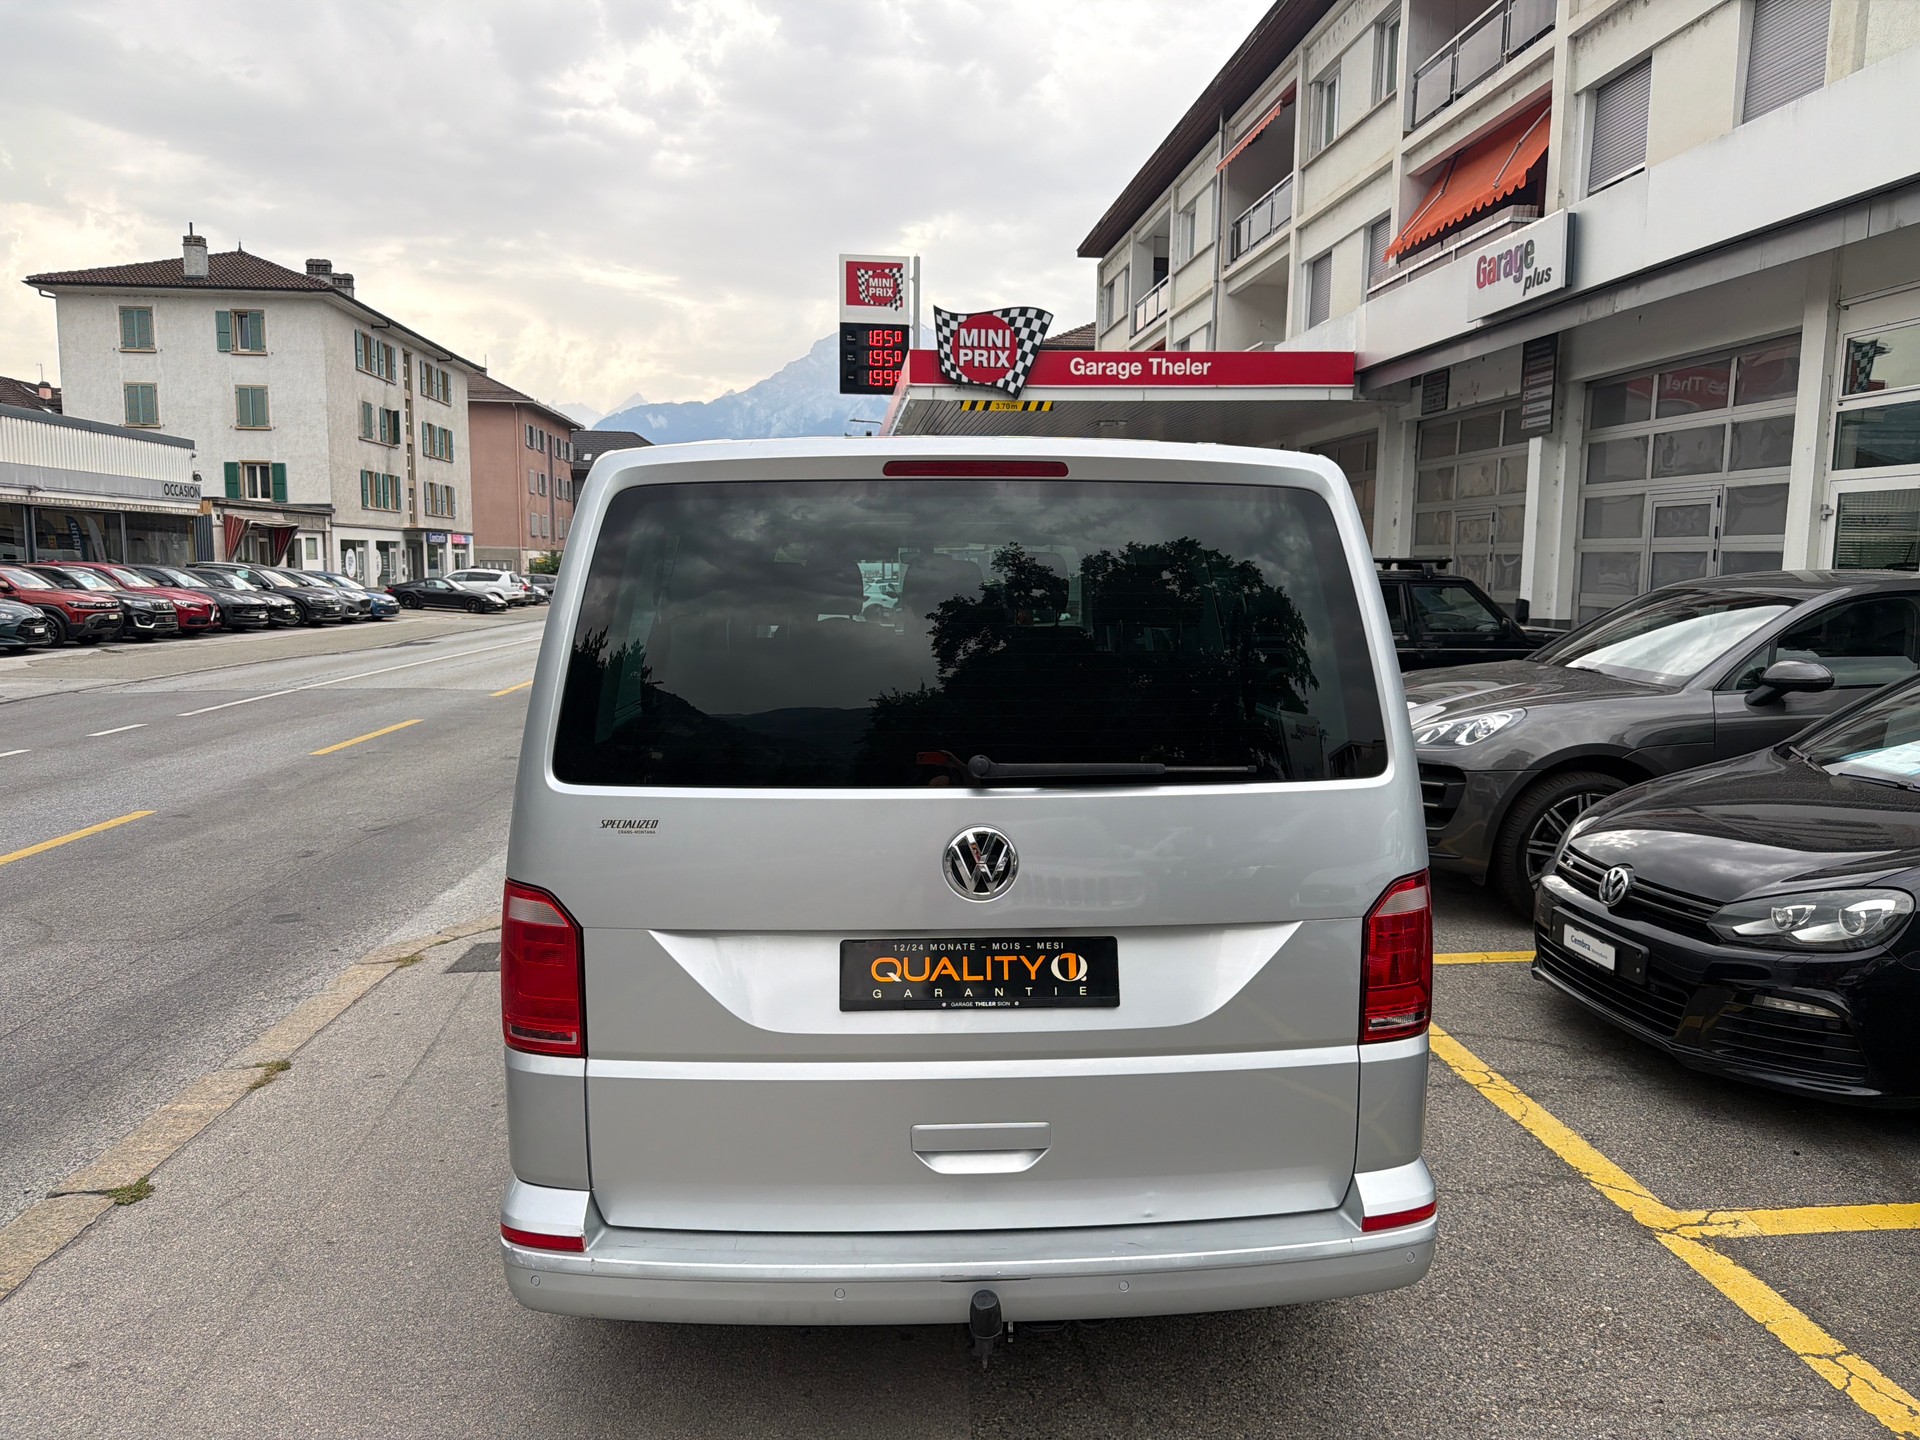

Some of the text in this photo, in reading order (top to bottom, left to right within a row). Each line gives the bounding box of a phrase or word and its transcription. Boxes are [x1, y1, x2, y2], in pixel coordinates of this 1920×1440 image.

[1476, 239, 1535, 289] Garage
[868, 278, 894, 287] MINI
[1522, 267, 1552, 296] plus
[868, 288, 894, 297] PRIX
[959, 328, 1011, 348] MINI
[958, 349, 1011, 369] PRIX
[1069, 357, 1212, 380] Garage Theler
[163, 483, 201, 499] OCCASION
[599, 819, 659, 829] SPECIALIZED
[893, 943, 924, 952] 12/24
[930, 943, 976, 951] MONATE
[992, 942, 1021, 950] MOIS
[1037, 942, 1064, 950] MESI
[1570, 934, 1591, 952] Cembra
[870, 955, 1046, 982] QUALITY
[872, 986, 1087, 999] GARANTIE
